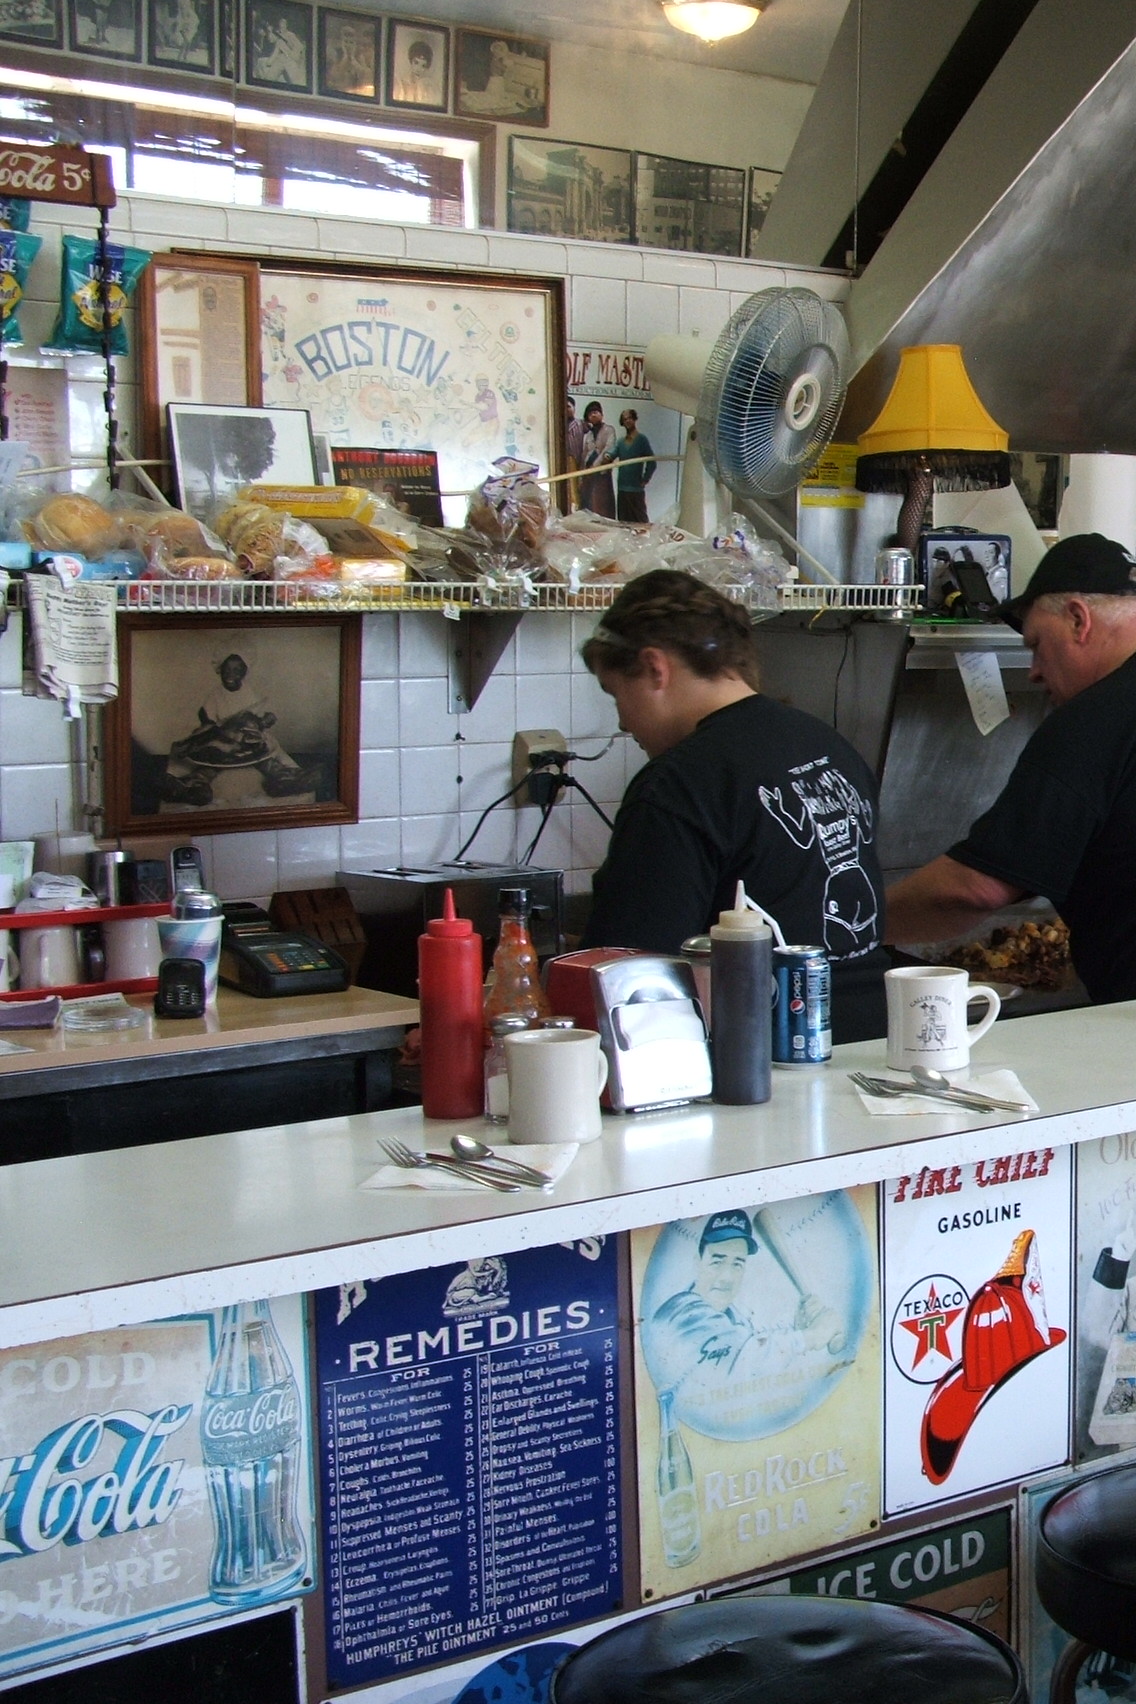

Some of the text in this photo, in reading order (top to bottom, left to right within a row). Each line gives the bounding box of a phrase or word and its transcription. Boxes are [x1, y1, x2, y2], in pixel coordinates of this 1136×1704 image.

[89, 263, 123, 285] WSE
[295, 319, 449, 387] BOSTON
[340, 465, 432, 480] NO RESERVATIONS
[909, 995, 933, 1008] GALLEY
[937, 1203, 1022, 1234] GASOLINE
[904, 1290, 964, 1318] TEXACO
[349, 1300, 591, 1373] REMEDIES
[523, 1342, 560, 1356] FOR
[918, 1314, 946, 1350] T
[697, 1335, 732, 1366] Says
[1, 1351, 156, 1397] COLD
[390, 1367, 431, 1383] FOR
[204, 1383, 297, 1439] Coca-Cola
[385, 1518, 419, 1536] Menses
[736, 1498, 808, 1543] COLA
[889, 1529, 986, 1589] COLD
[37, 1547, 182, 1609] HERE
[345, 1624, 397, 1647] Ophthalmia
[408, 1614, 430, 1630] Sore
[417, 1642, 439, 1659] PILE
[442, 1626, 497, 1654] OINTMENT
[503, 1624, 518, 1634] 25
[519, 1619, 533, 1630] and
[534, 1615, 549, 1625] 50
[551, 1610, 570, 1621] Cents
[424, 1622, 463, 1641] WITCH
[467, 1611, 502, 1631] HAZEL
[506, 1595, 559, 1620] OINTMENT
